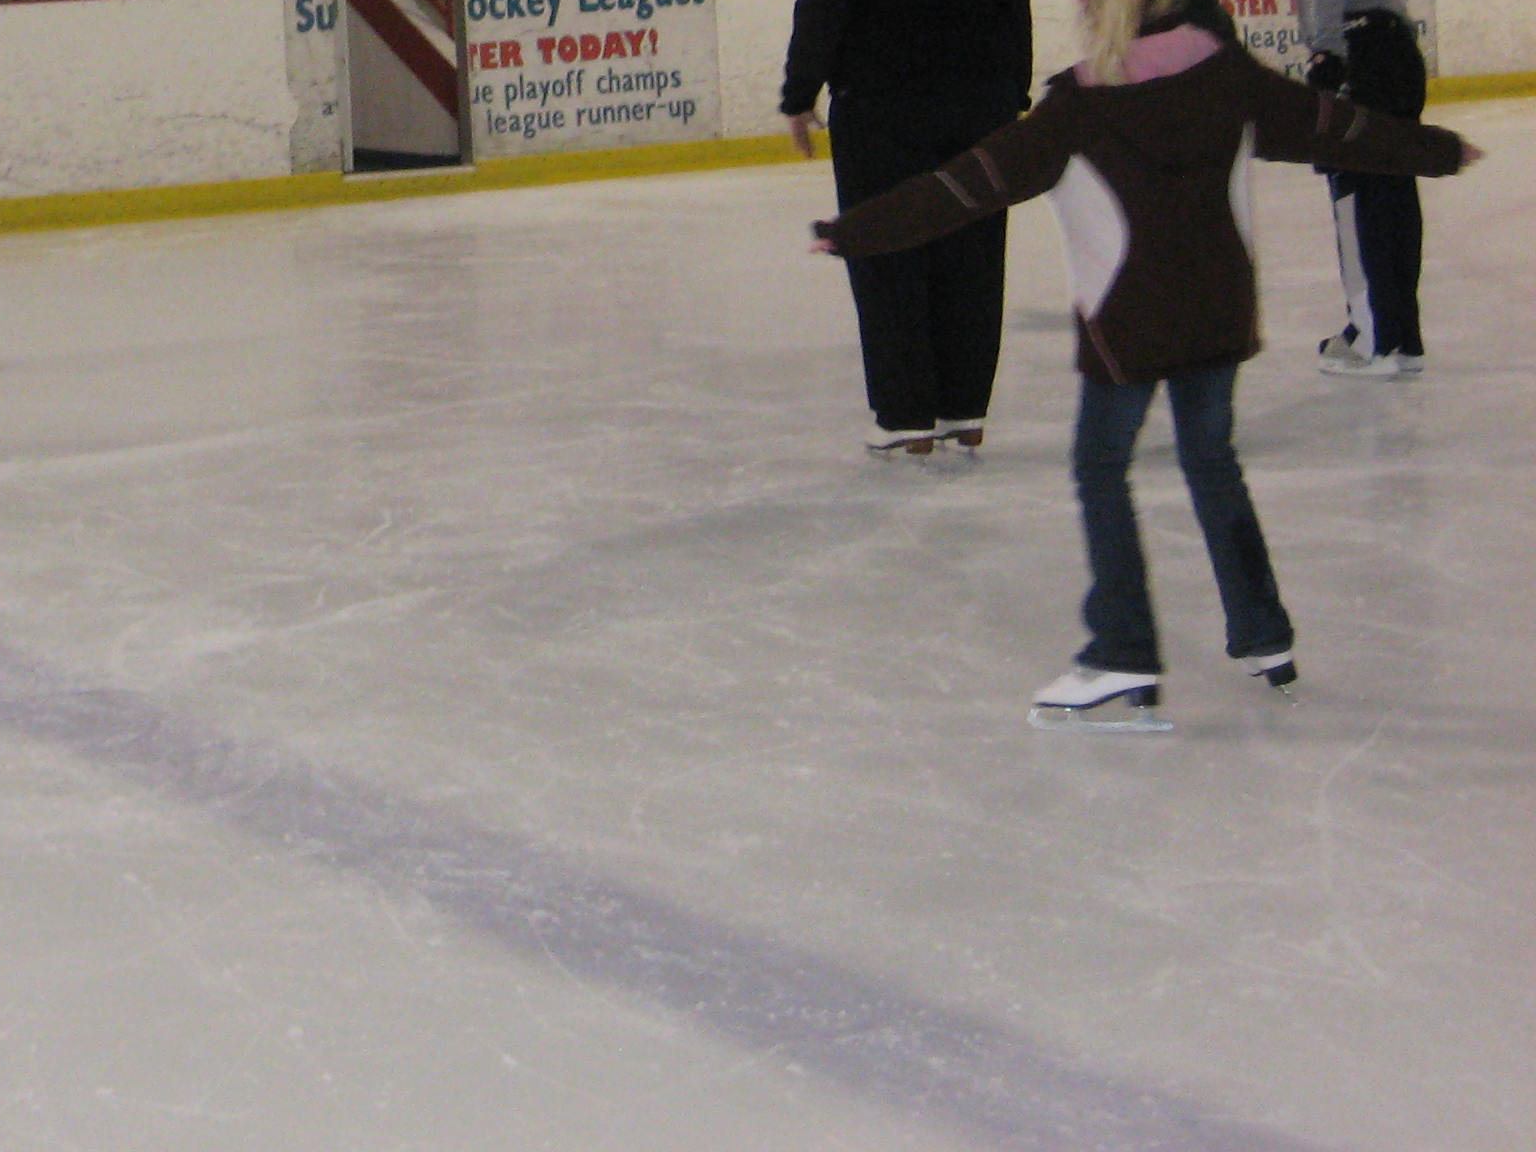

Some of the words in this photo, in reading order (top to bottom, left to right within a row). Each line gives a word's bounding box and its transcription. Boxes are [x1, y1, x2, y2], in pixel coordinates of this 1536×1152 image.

[537, 28, 659, 65] TODAY!
[504, 69, 586, 110] playoff
[596, 67, 682, 97] champs
[486, 108, 565, 139] league
[576, 98, 697, 127] runner-up
